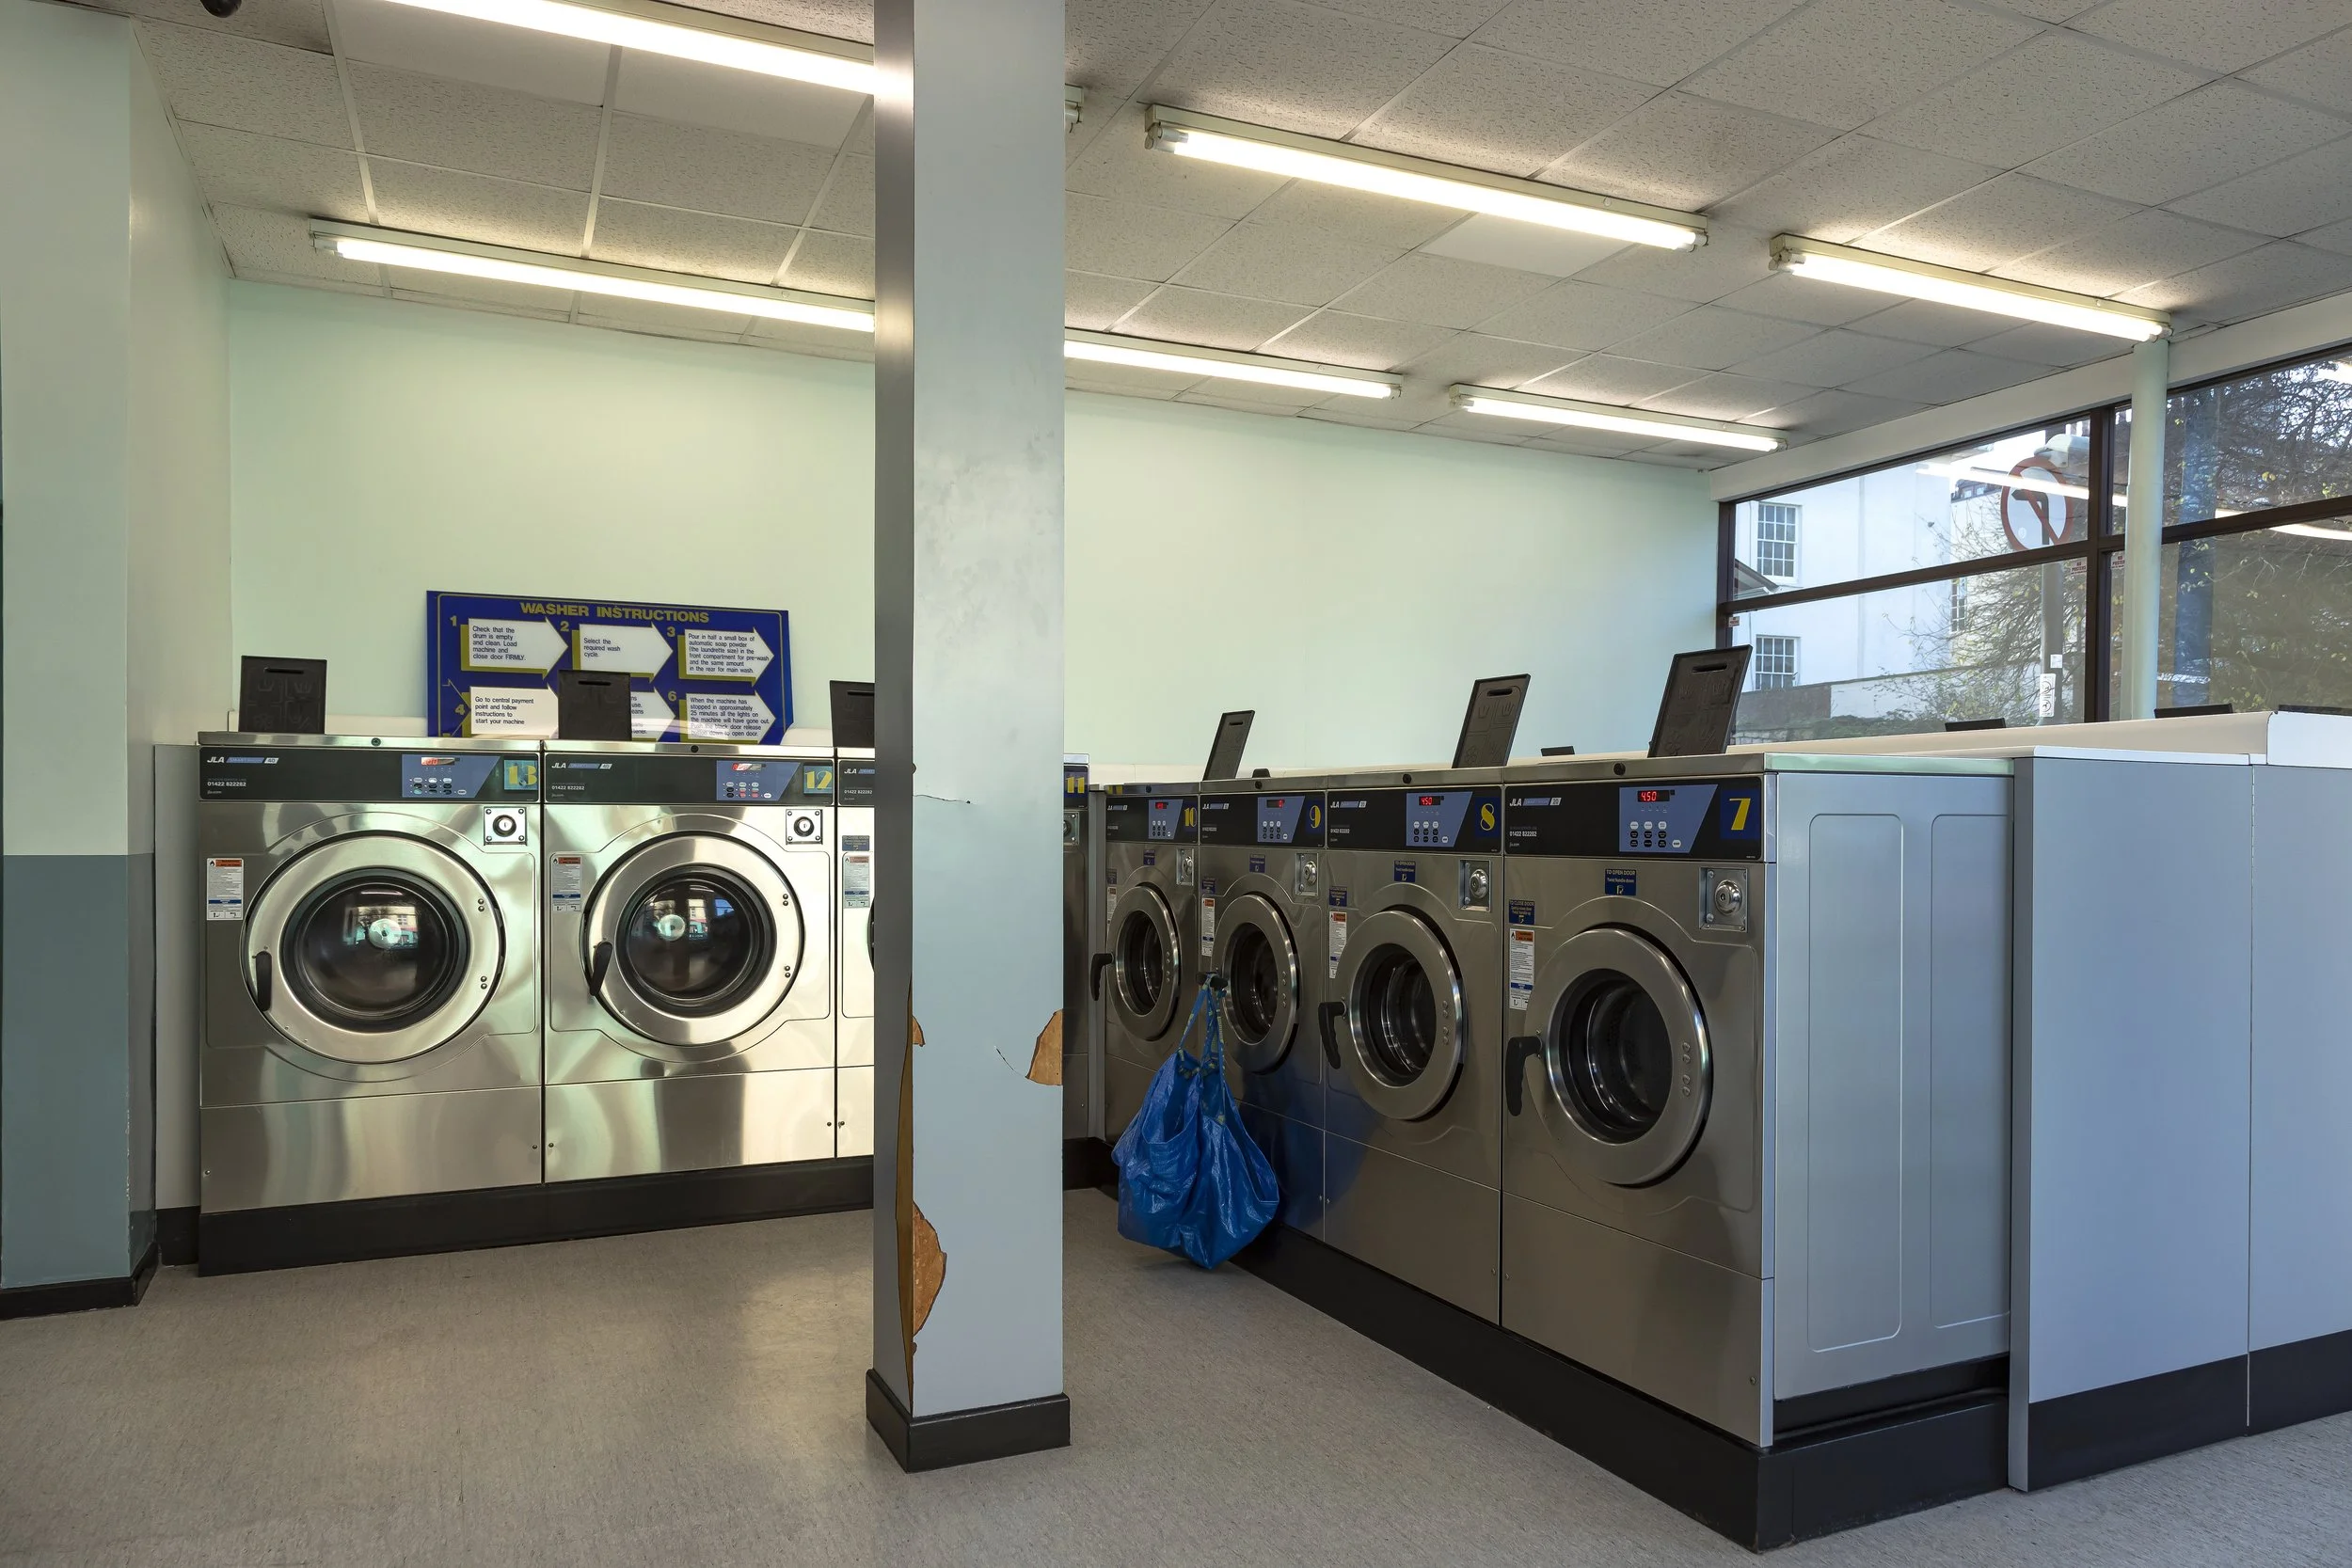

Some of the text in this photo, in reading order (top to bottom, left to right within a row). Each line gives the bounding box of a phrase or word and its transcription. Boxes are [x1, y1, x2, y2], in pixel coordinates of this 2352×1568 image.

[450, 615, 457, 627] 1
[520, 602, 709, 623] WASHER INSTRUCTIONS
[560, 621, 569, 632] 2
[667, 626, 675, 637] 3
[668, 691, 677, 702] 6
[455, 704, 465, 715] 4
[509, 765, 537, 785] 13
[805, 771, 832, 789] 12
[1065, 776, 1084, 793] 11
[1184, 807, 1197, 827] 10
[1309, 805, 1321, 828] 9
[1480, 803, 1495, 831] 8
[1729, 798, 1751, 830] 7
